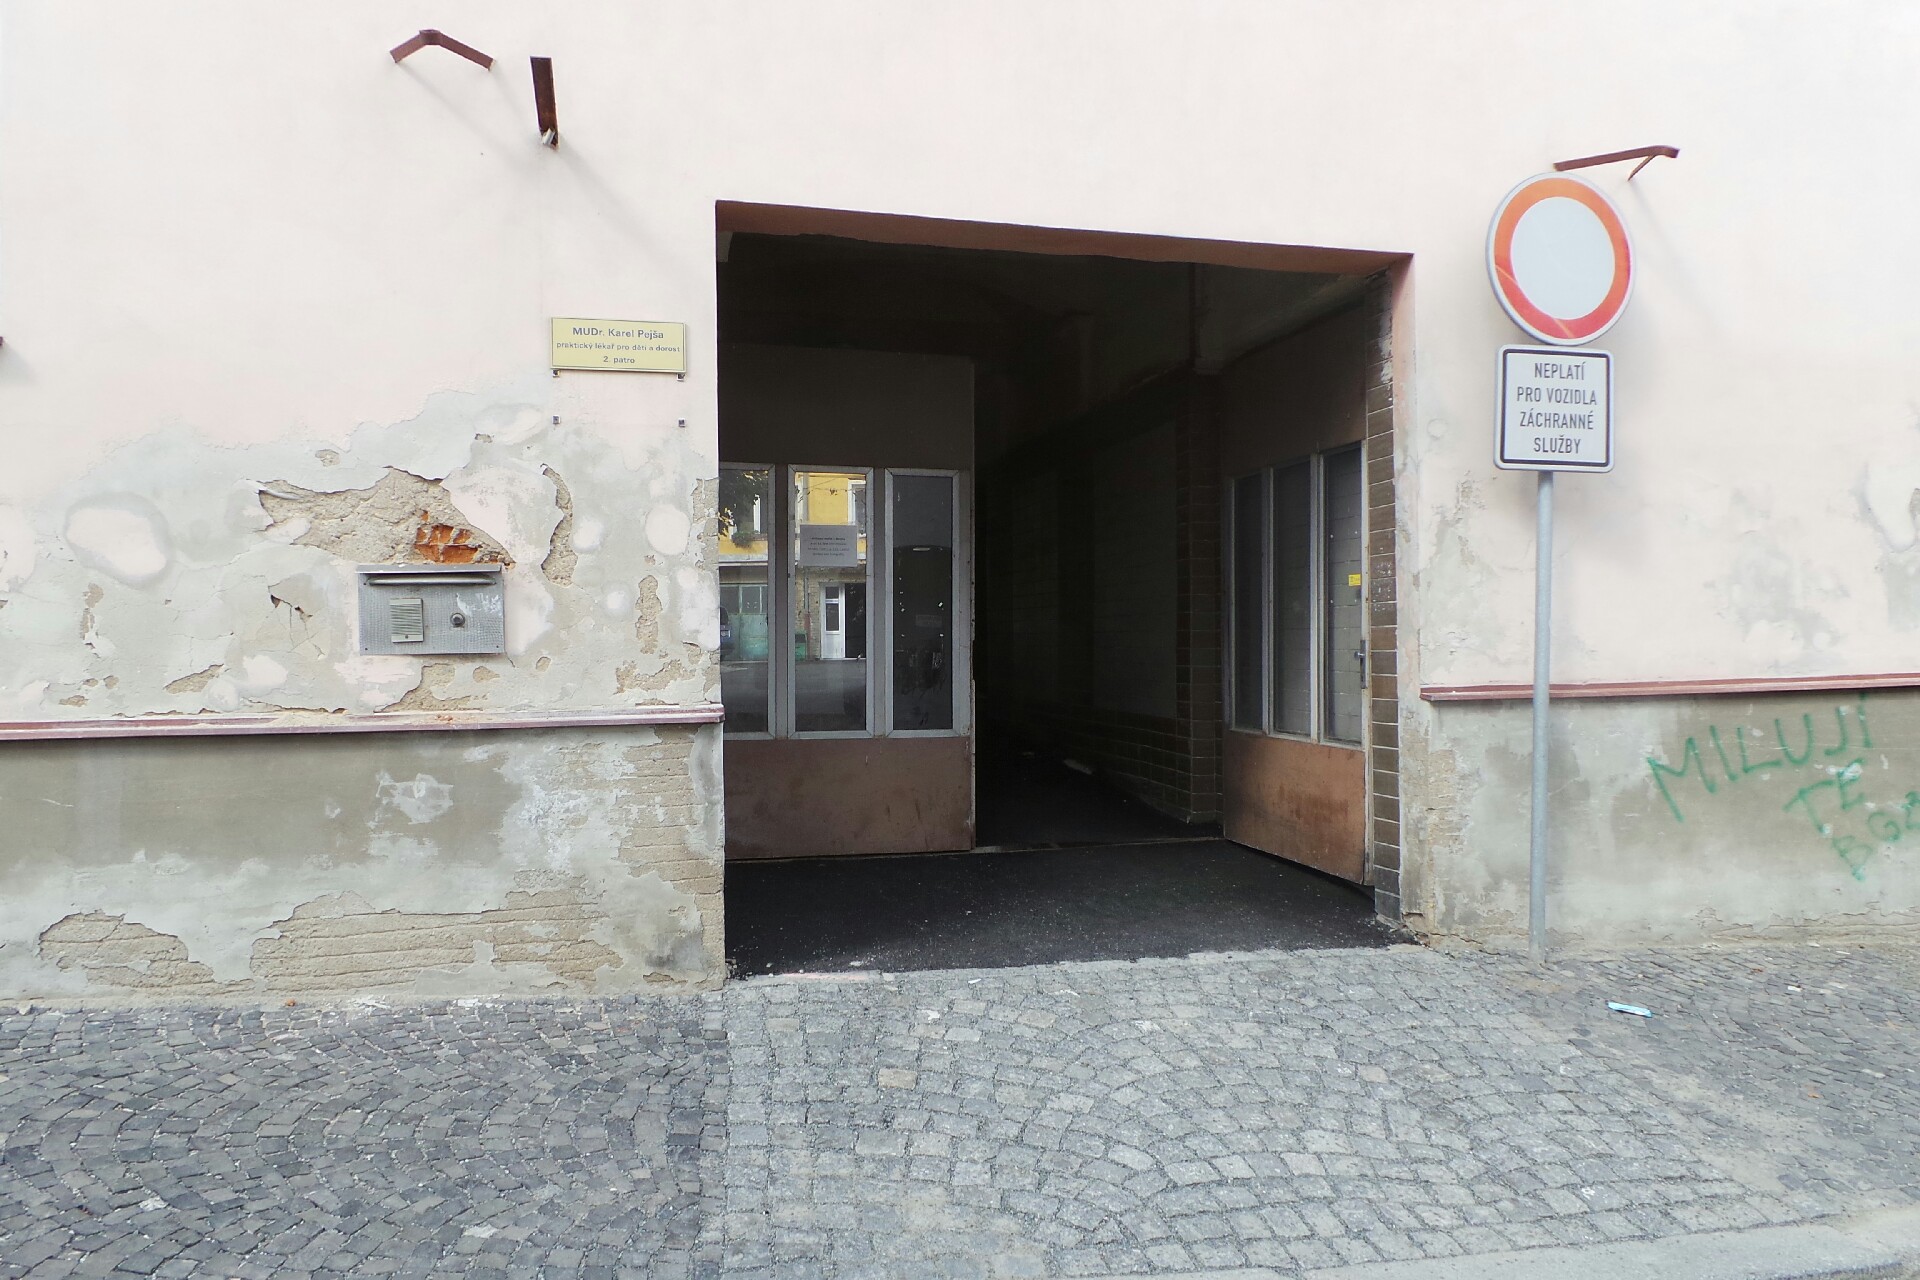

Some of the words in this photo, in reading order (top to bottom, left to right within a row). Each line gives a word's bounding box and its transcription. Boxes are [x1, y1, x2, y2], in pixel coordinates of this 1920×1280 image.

[572, 327, 605, 337] MUDr.
[608, 328, 635, 338] Karel
[556, 341, 593, 350] praktický
[595, 342, 615, 350] lékař
[655, 344, 681, 352] dorost
[613, 356, 636, 364] patro
[1534, 361, 1586, 381] NEPLATÍ
[1516, 386, 1542, 402] PRO
[1546, 387, 1598, 405] VOZIDLA
[1519, 408, 1595, 430] ZÁCHRANNÉ
[1533, 435, 1582, 454] SLUŽBY
[1646, 693, 1874, 823] MILUJI
